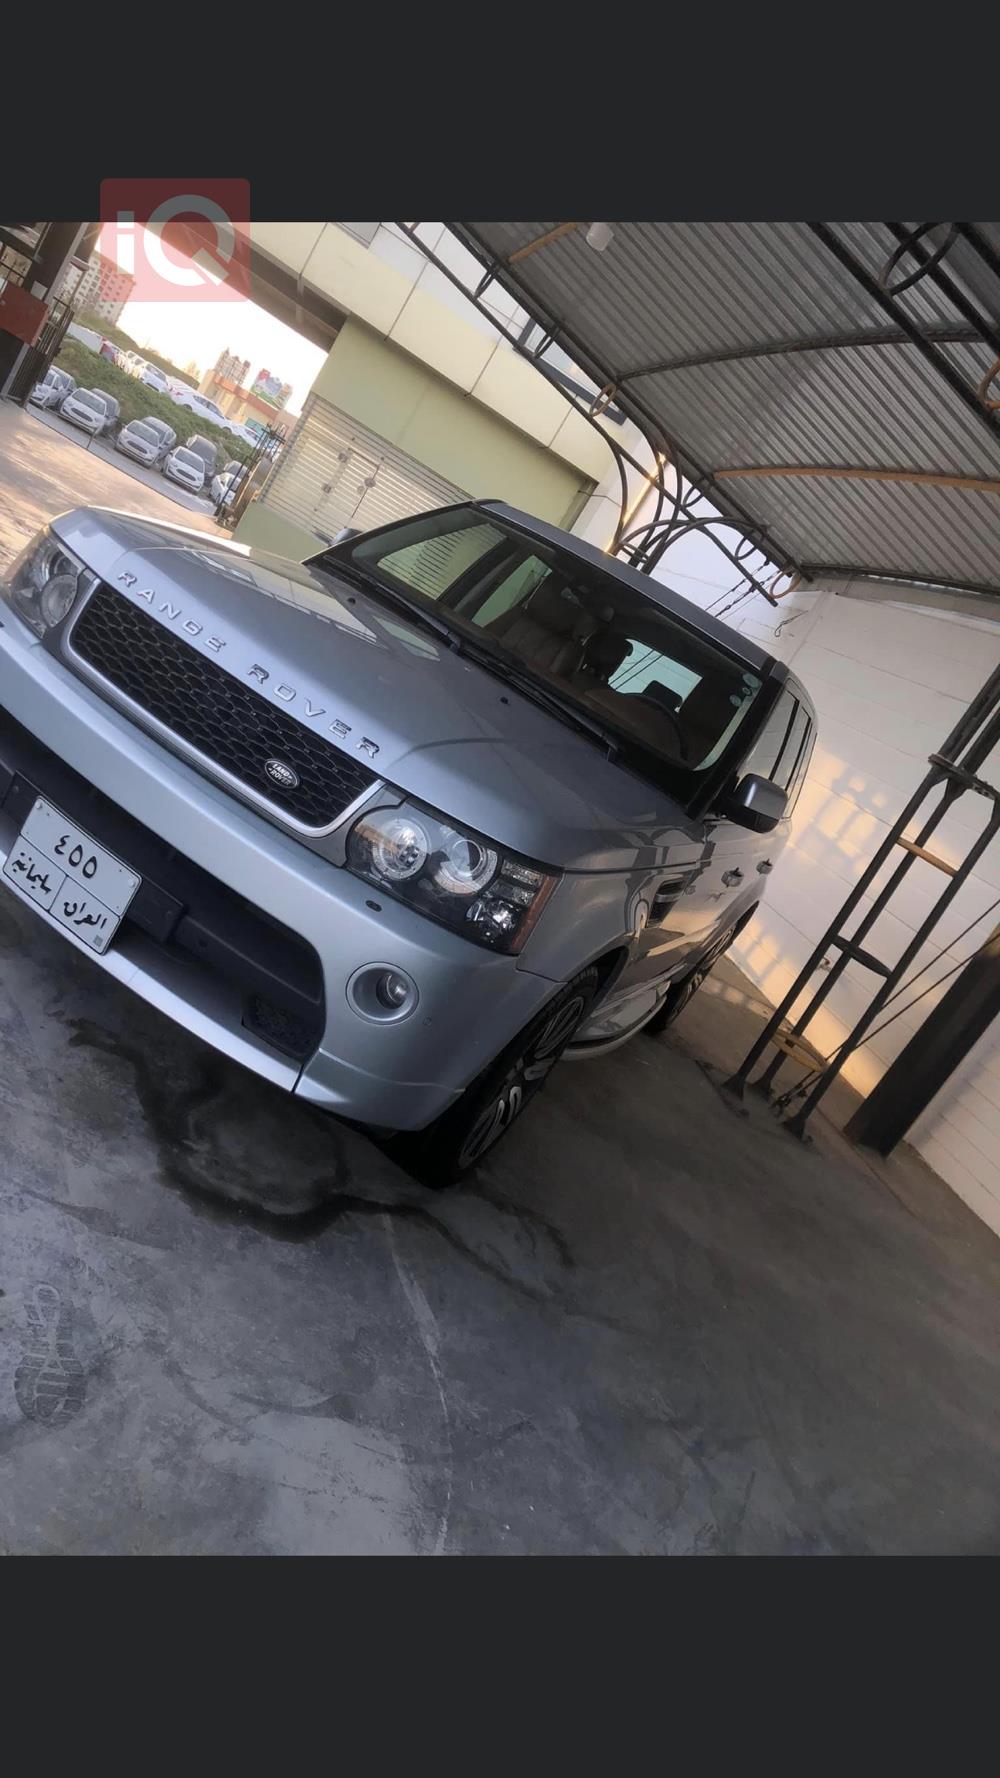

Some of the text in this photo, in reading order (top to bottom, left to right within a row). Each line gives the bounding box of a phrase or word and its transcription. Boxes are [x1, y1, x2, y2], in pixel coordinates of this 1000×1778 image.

[118, 571, 380, 758] RANGE ROVER
[270, 769, 291, 786] ROVER
[272, 763, 290, 777] LAND
[54, 835, 97, 878] ٤٥٥
